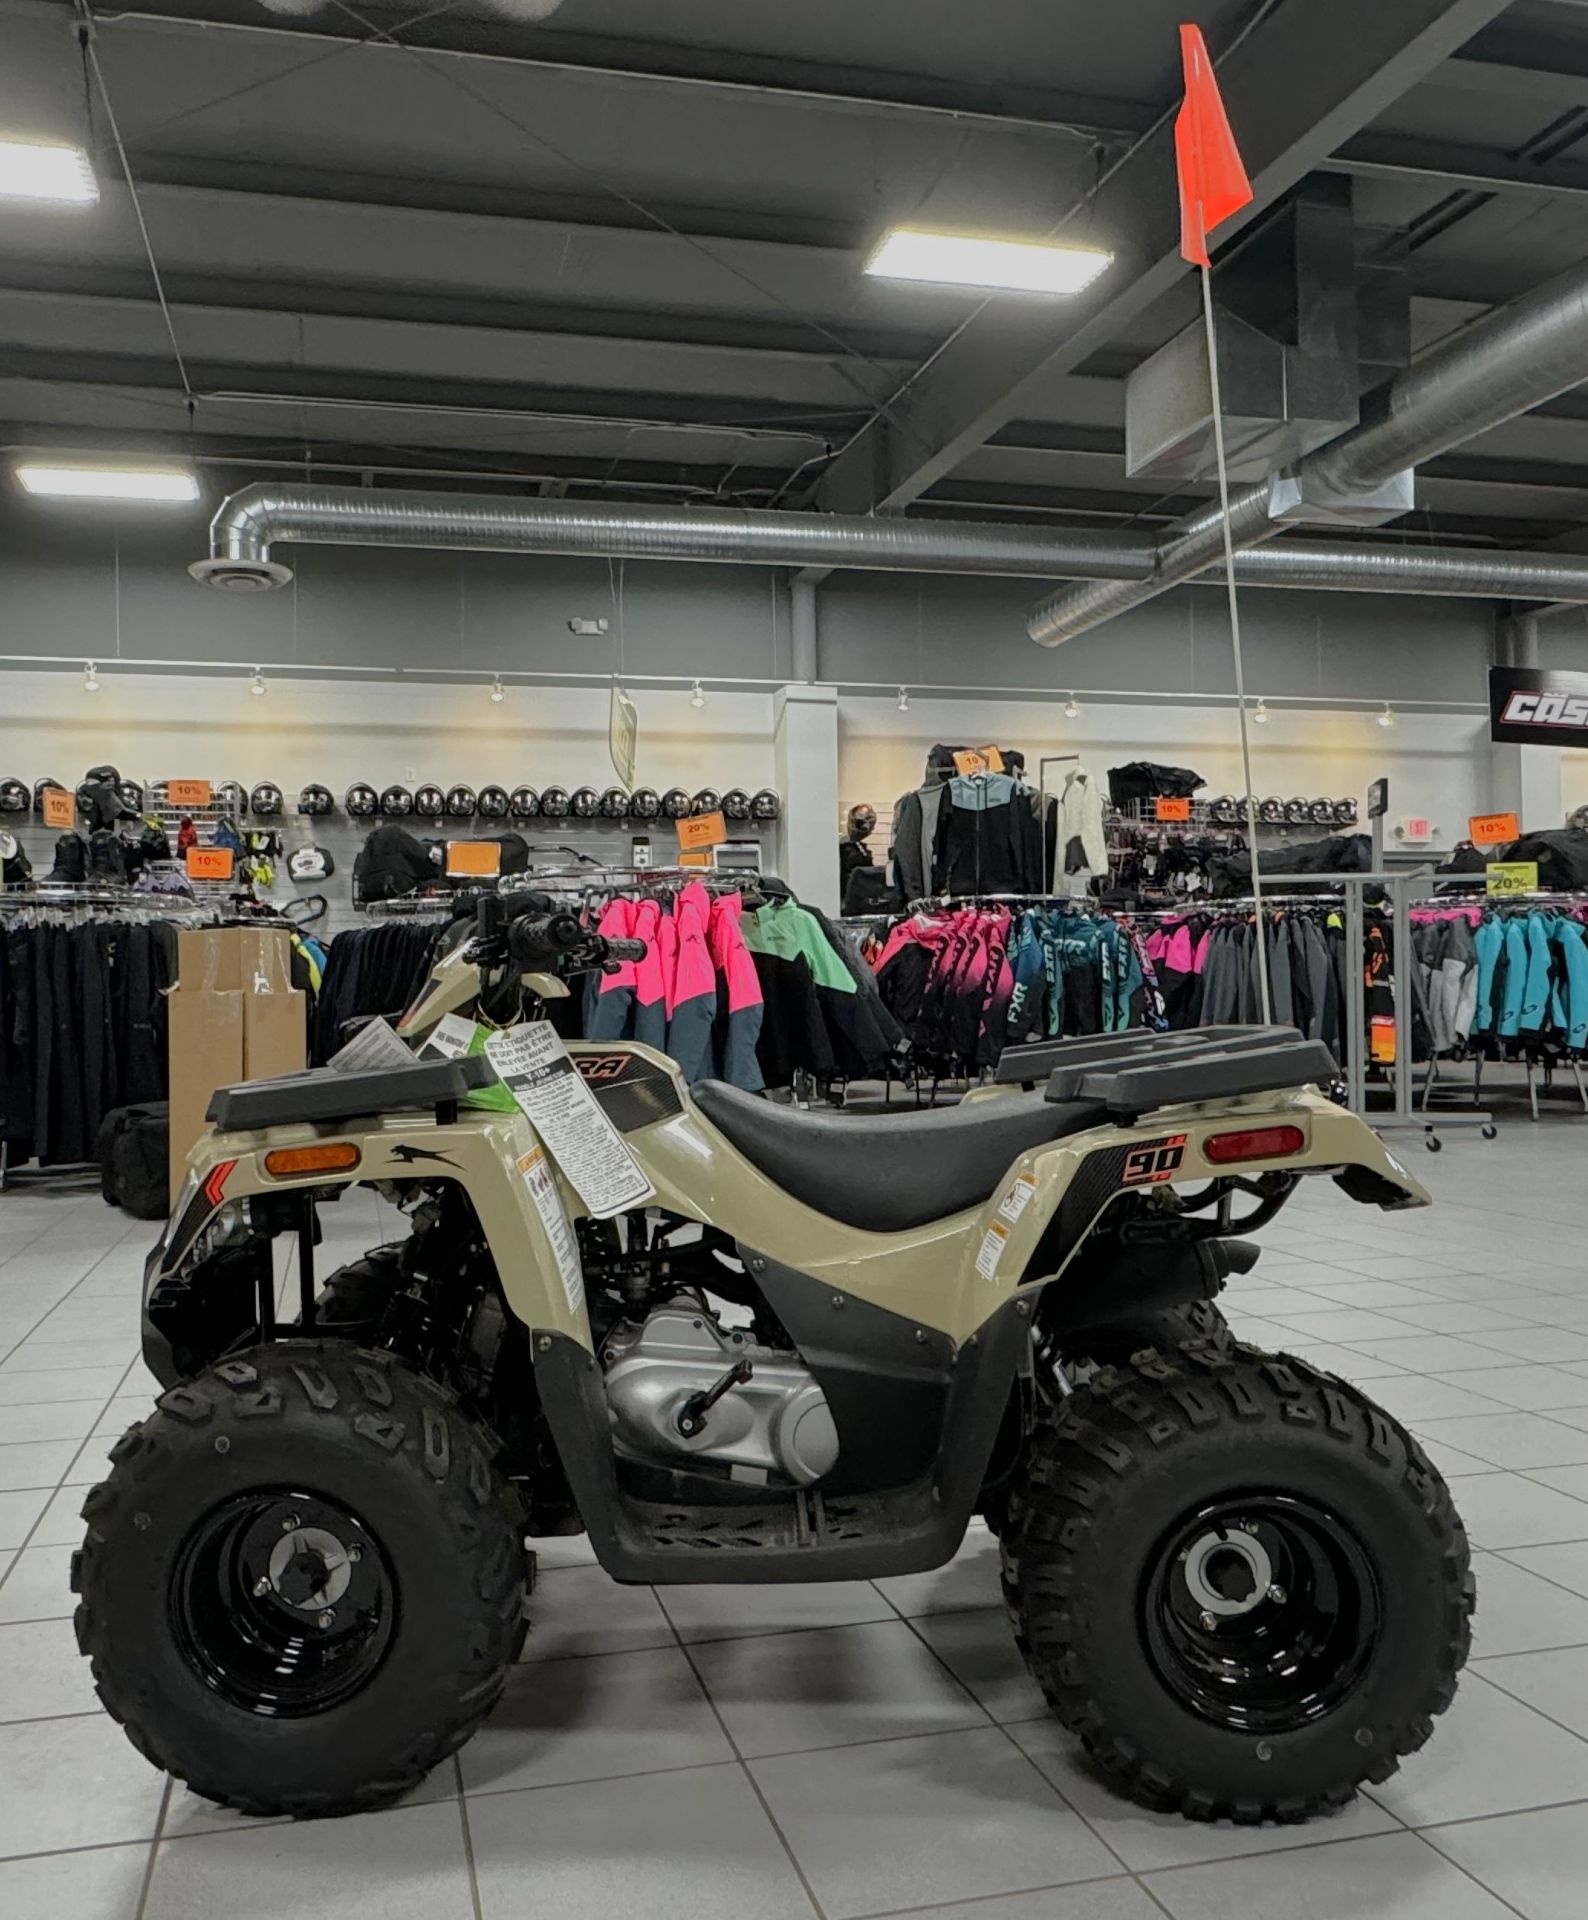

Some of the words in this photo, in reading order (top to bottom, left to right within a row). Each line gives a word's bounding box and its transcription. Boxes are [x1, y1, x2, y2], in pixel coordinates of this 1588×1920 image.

[1502, 692, 1588, 728] CAS
[177, 785, 201, 796] 10%
[51, 799, 69, 814] 10%
[1162, 805, 1181, 814] 10%
[687, 822, 710, 833] 20%
[1479, 823, 1506, 834] 10%
[197, 856, 222, 867] 10%
[1492, 877, 1528, 890] 20%
[1007, 982, 1028, 1023] FXR
[515, 1043, 531, 1055] PAS
[532, 1031, 554, 1046] ÊTRE
[528, 1043, 554, 1059] AVANT
[522, 1057, 545, 1071] VENTE
[1125, 1144, 1185, 1179] 90
